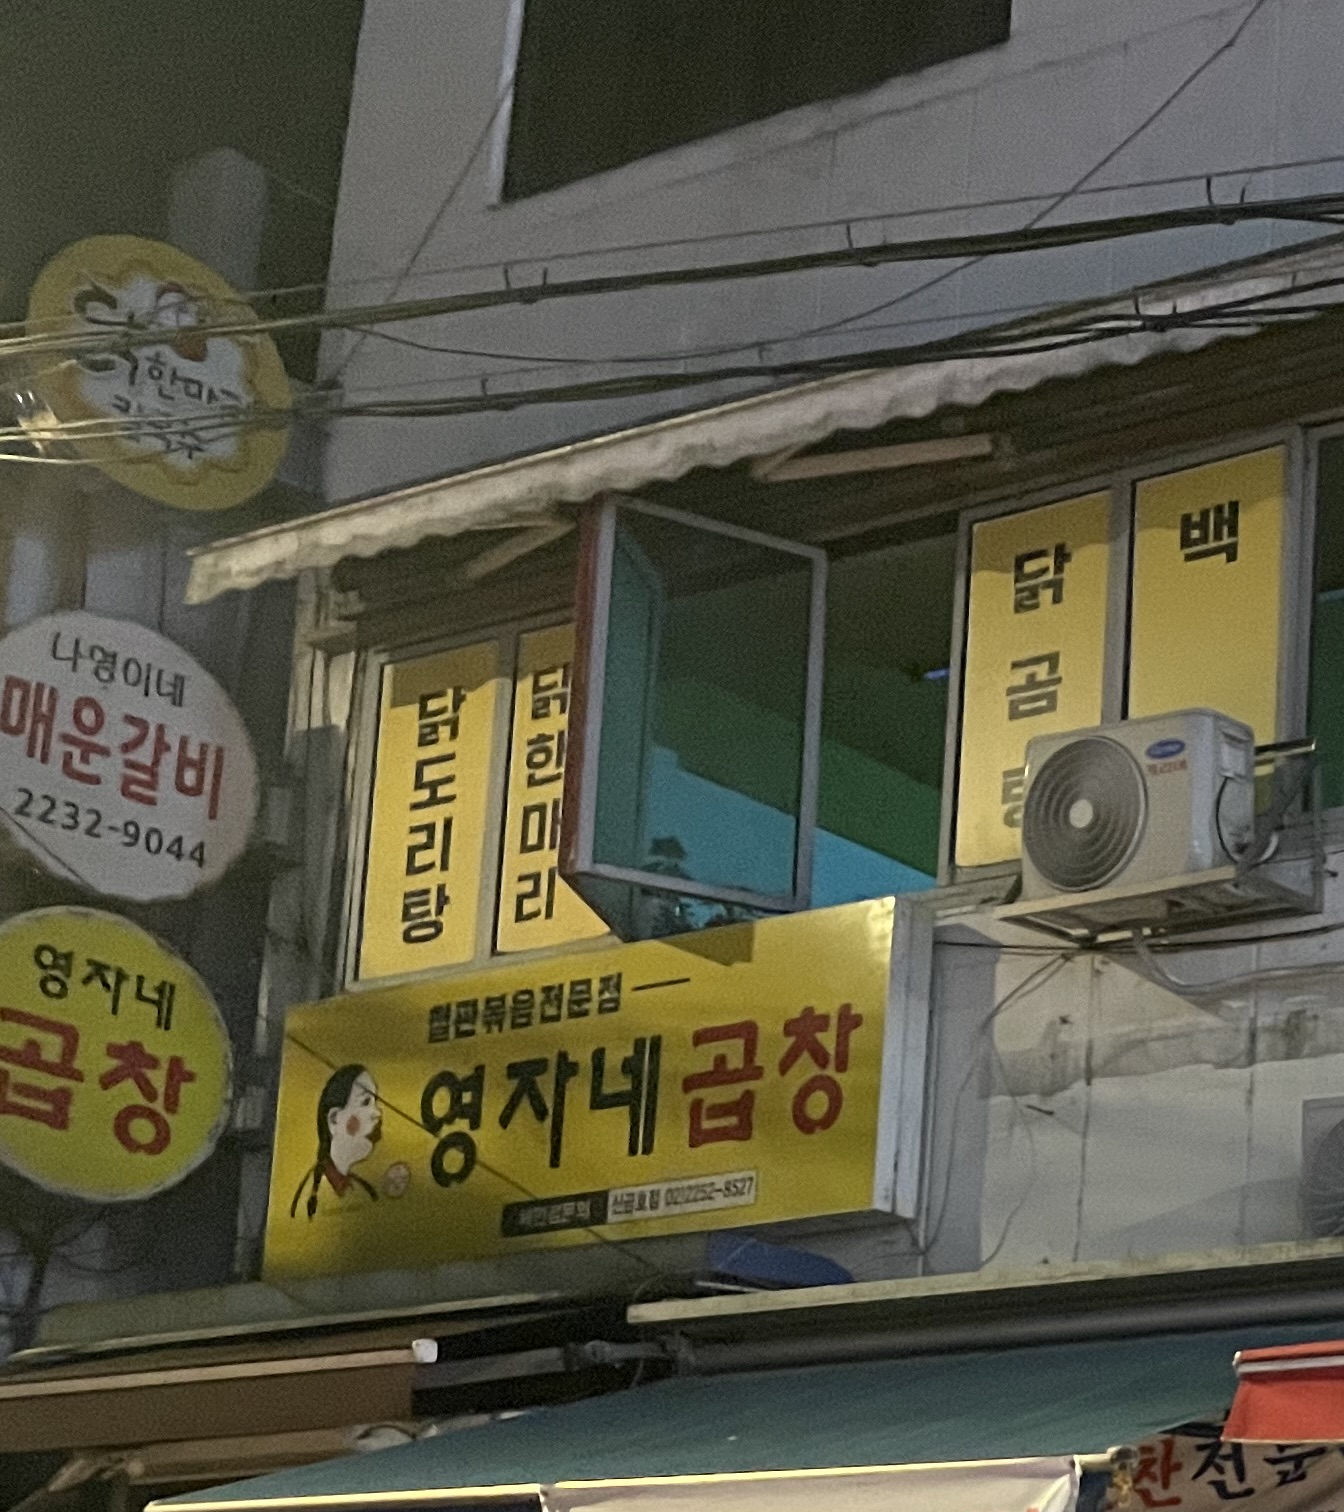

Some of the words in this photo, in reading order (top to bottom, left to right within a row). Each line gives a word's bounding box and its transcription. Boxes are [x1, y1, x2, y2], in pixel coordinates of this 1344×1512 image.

[51, 630, 188, 709] 나영이네
[1, 674, 226, 821] 매운갈비
[15, 786, 208, 869] 2232-9044
[401, 685, 466, 945] 닭도리탕
[33, 941, 178, 1032] 영자네
[420, 1035, 662, 1188] 영자네
[682, 1003, 863, 1148] 곱창
